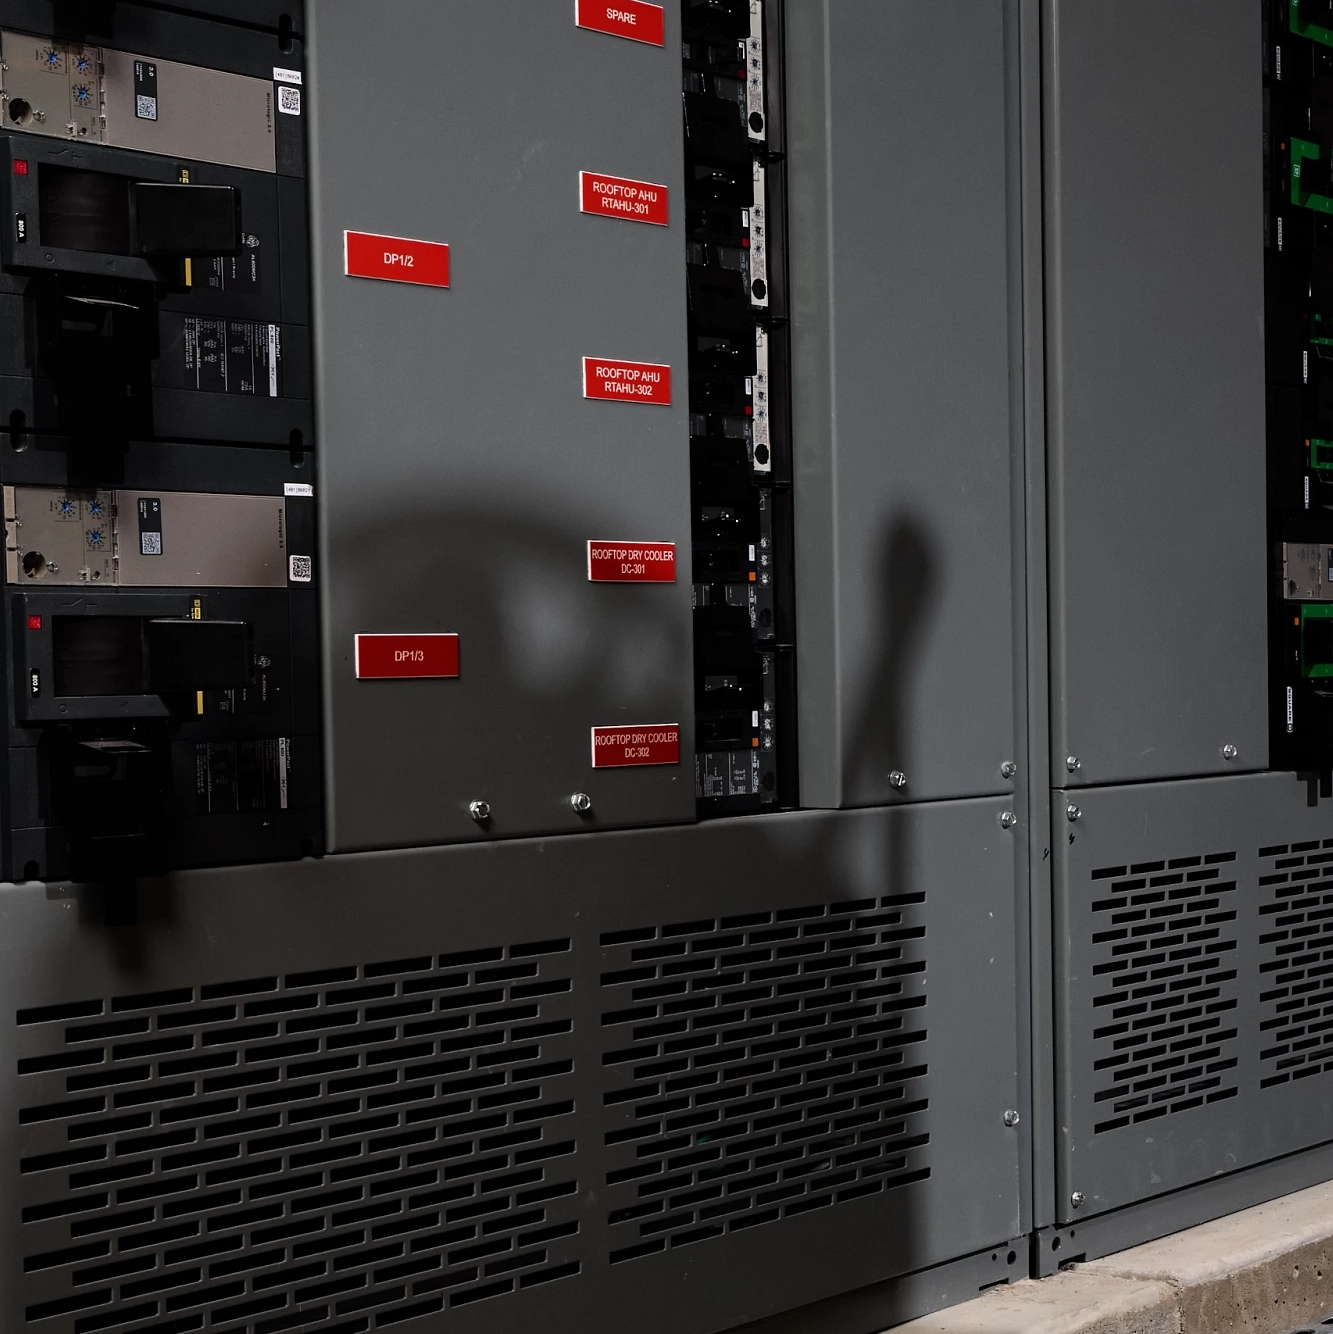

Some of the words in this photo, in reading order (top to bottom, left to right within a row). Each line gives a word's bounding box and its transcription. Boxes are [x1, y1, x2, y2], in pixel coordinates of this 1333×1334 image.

[607, 8, 637, 25] SPARE
[593, 181, 637, 198] ROOFTOP
[639, 191, 657, 203] AHU
[602, 197, 649, 214] RTAHU-301
[383, 252, 414, 267] DP1/2
[596, 366, 640, 381] ROOFTOP
[641, 372, 660, 383] AHU
[604, 381, 652, 396] RTAHU-302
[592, 548, 627, 560] ROOFTOP
[628, 549, 643, 560] DRY
[644, 549, 674, 561] COOLER
[621, 563, 645, 574] DC-301
[394, 650, 424, 662] DP1/3
[595, 734, 631, 746] ROOFTOP
[631, 734, 647, 744] DRY
[648, 732, 678, 743] COOLER
[625, 746, 650, 758] DC-302
